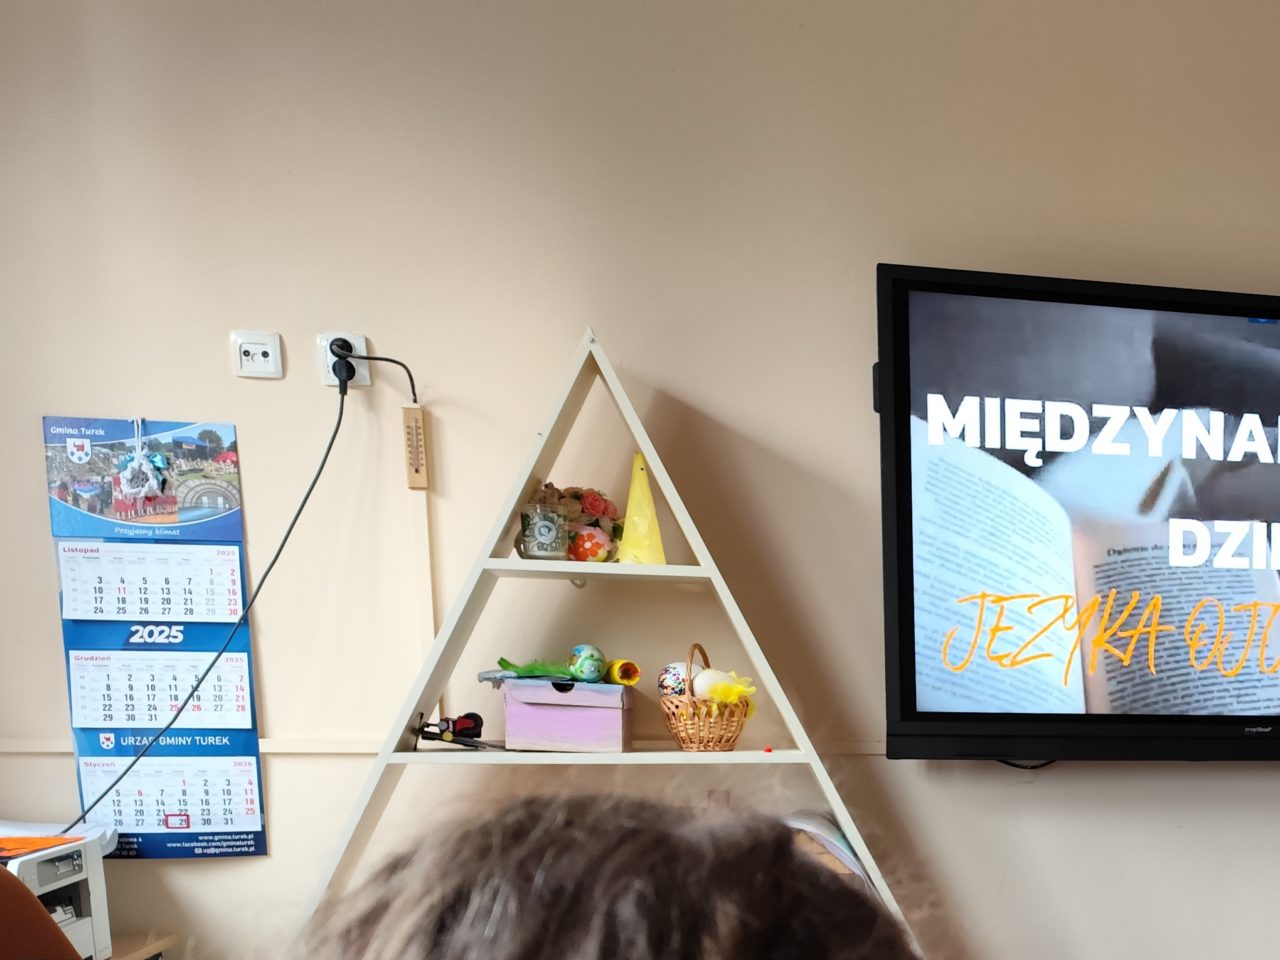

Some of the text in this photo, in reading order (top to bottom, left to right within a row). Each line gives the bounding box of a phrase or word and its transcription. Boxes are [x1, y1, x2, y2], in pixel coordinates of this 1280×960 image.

[50, 427, 105, 436] Gmina Turek
[205, 588, 215, 596] 15
[139, 597, 149, 605] 19
[205, 598, 215, 606] 22
[129, 625, 184, 643] 2025
[106, 674, 110, 682] 1
[150, 674, 155, 682] 3
[172, 674, 177, 682] 4
[195, 674, 200, 682] 5
[169, 684, 178, 692] 11
[125, 694, 134, 702] 16
[147, 694, 156, 702] 17
[159, 737, 191, 745] GMINY
[194, 737, 230, 745] TUREK
[112, 799, 121, 807] 12
[134, 799, 143, 807] 13
